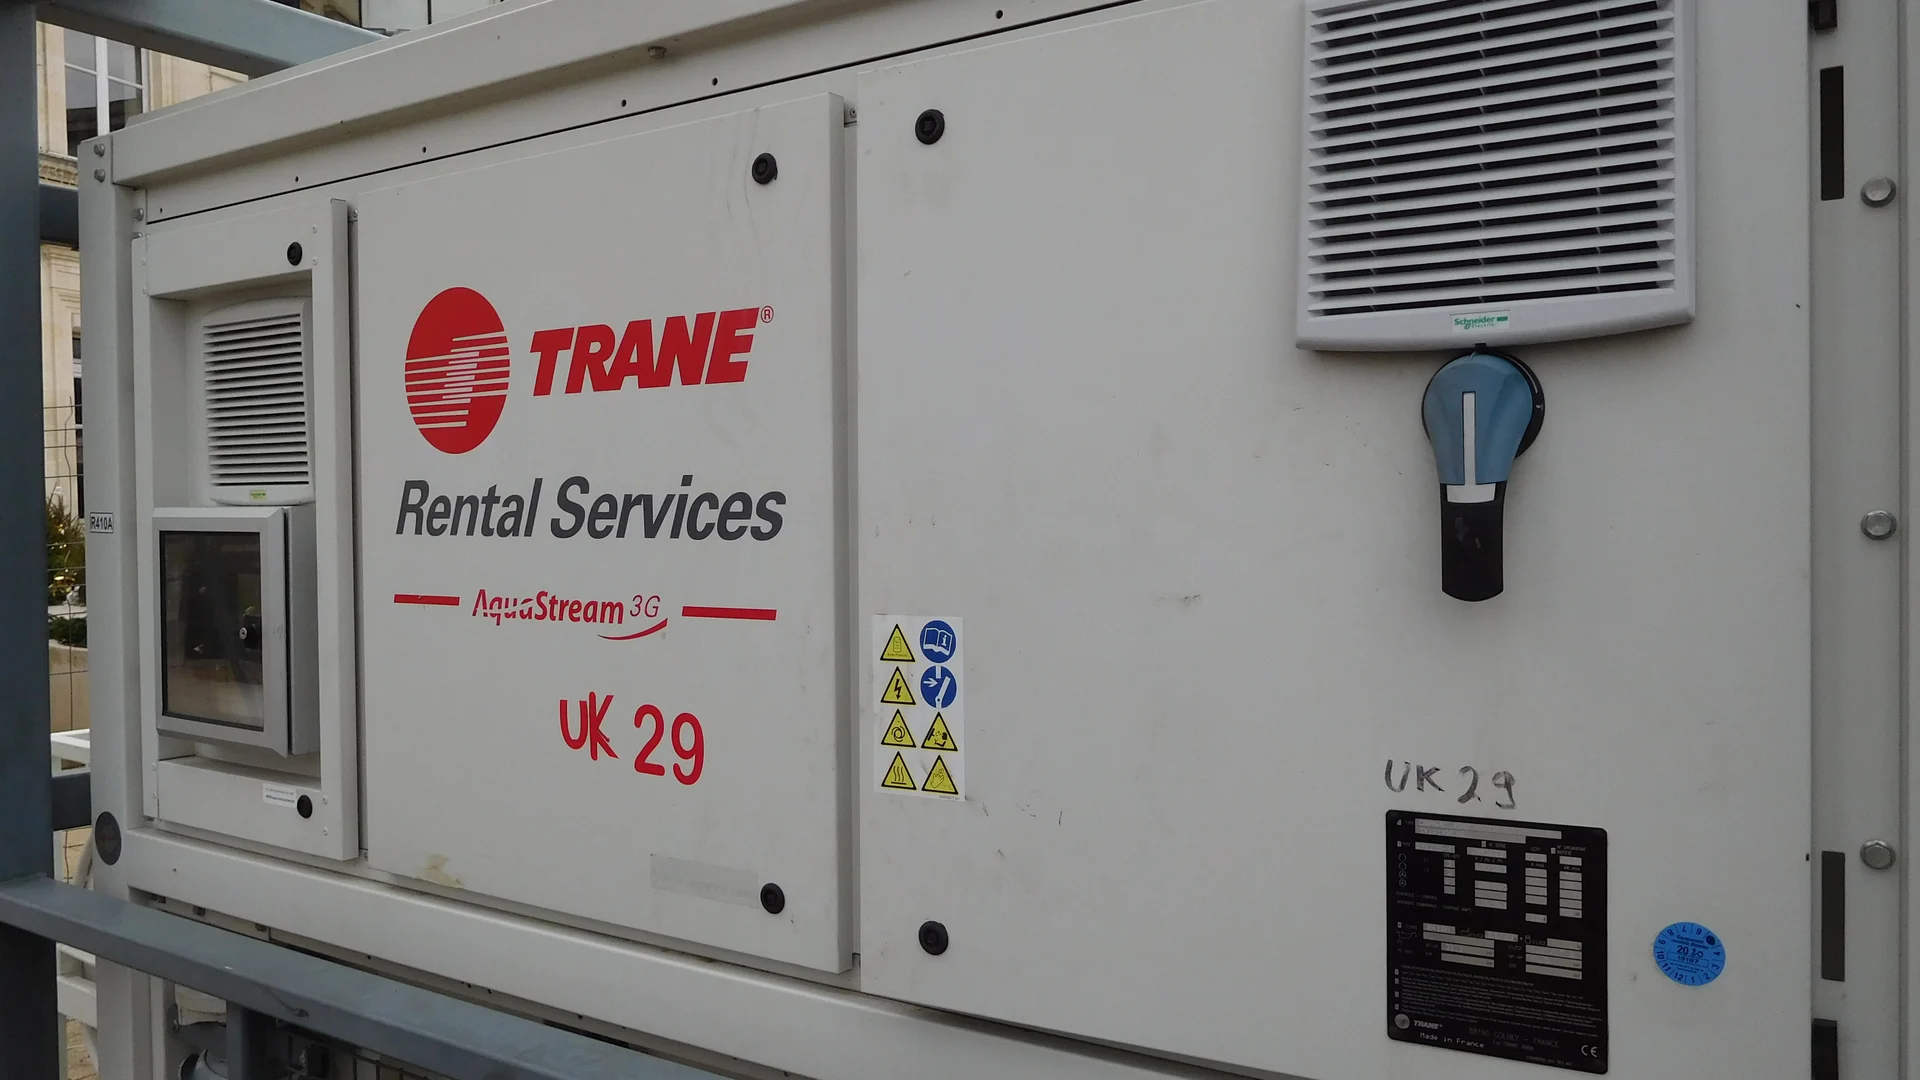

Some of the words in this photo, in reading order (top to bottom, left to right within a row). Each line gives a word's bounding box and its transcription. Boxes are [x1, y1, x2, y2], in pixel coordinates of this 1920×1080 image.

[1454, 315, 1496, 326] Schneider
[395, 477, 543, 538] Rental
[550, 474, 787, 541] Services
[90, 516, 114, 530] R410A
[472, 588, 624, 626] AquaStream
[629, 594, 661, 618] 3G
[559, 691, 619, 761] UK
[633, 703, 705, 786] 29
[1384, 759, 1445, 792] UK
[1458, 765, 1517, 810] 29
[1674, 972, 1683, 981] 12
[1420, 1031, 1439, 1042] Made
[1444, 1036, 1454, 1044] in
[1456, 1037, 1485, 1049] France
